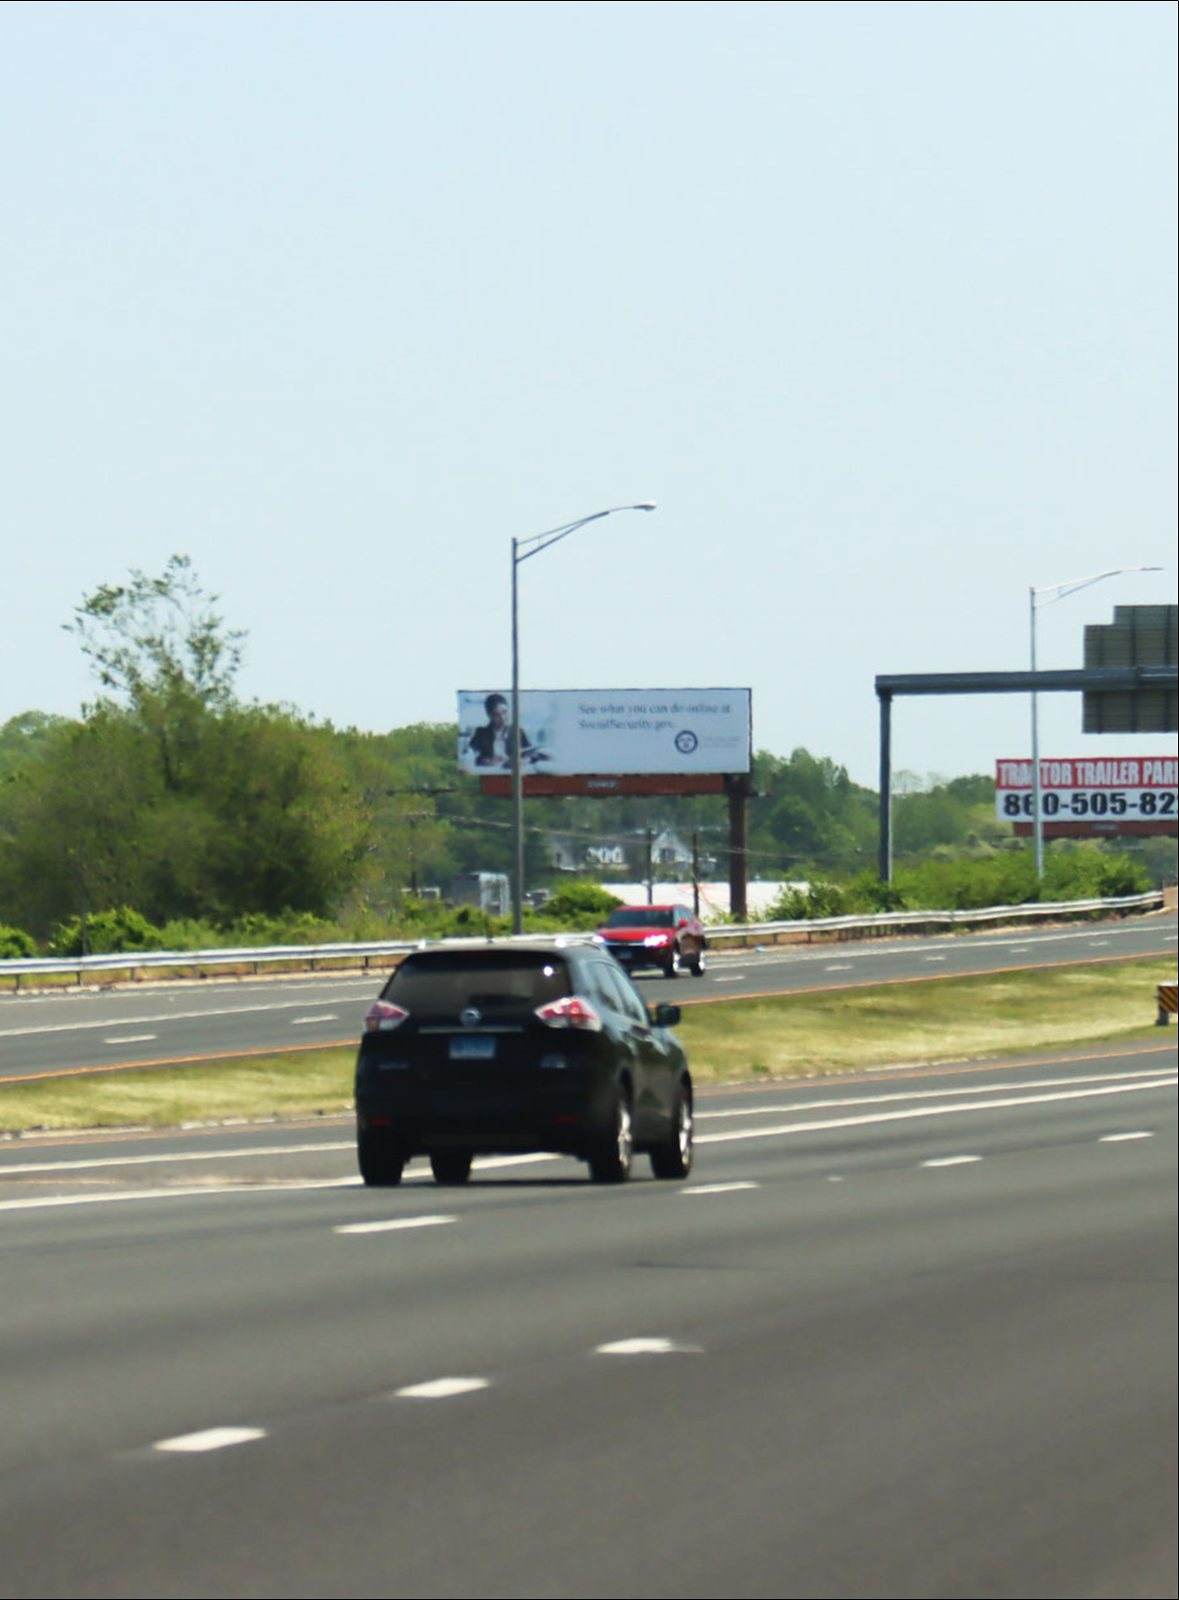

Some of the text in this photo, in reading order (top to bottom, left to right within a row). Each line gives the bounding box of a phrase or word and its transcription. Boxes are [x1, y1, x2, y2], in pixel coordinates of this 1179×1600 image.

[578, 702, 731, 717] See what you can do online at
[1075, 761, 1140, 785] TRAILER
